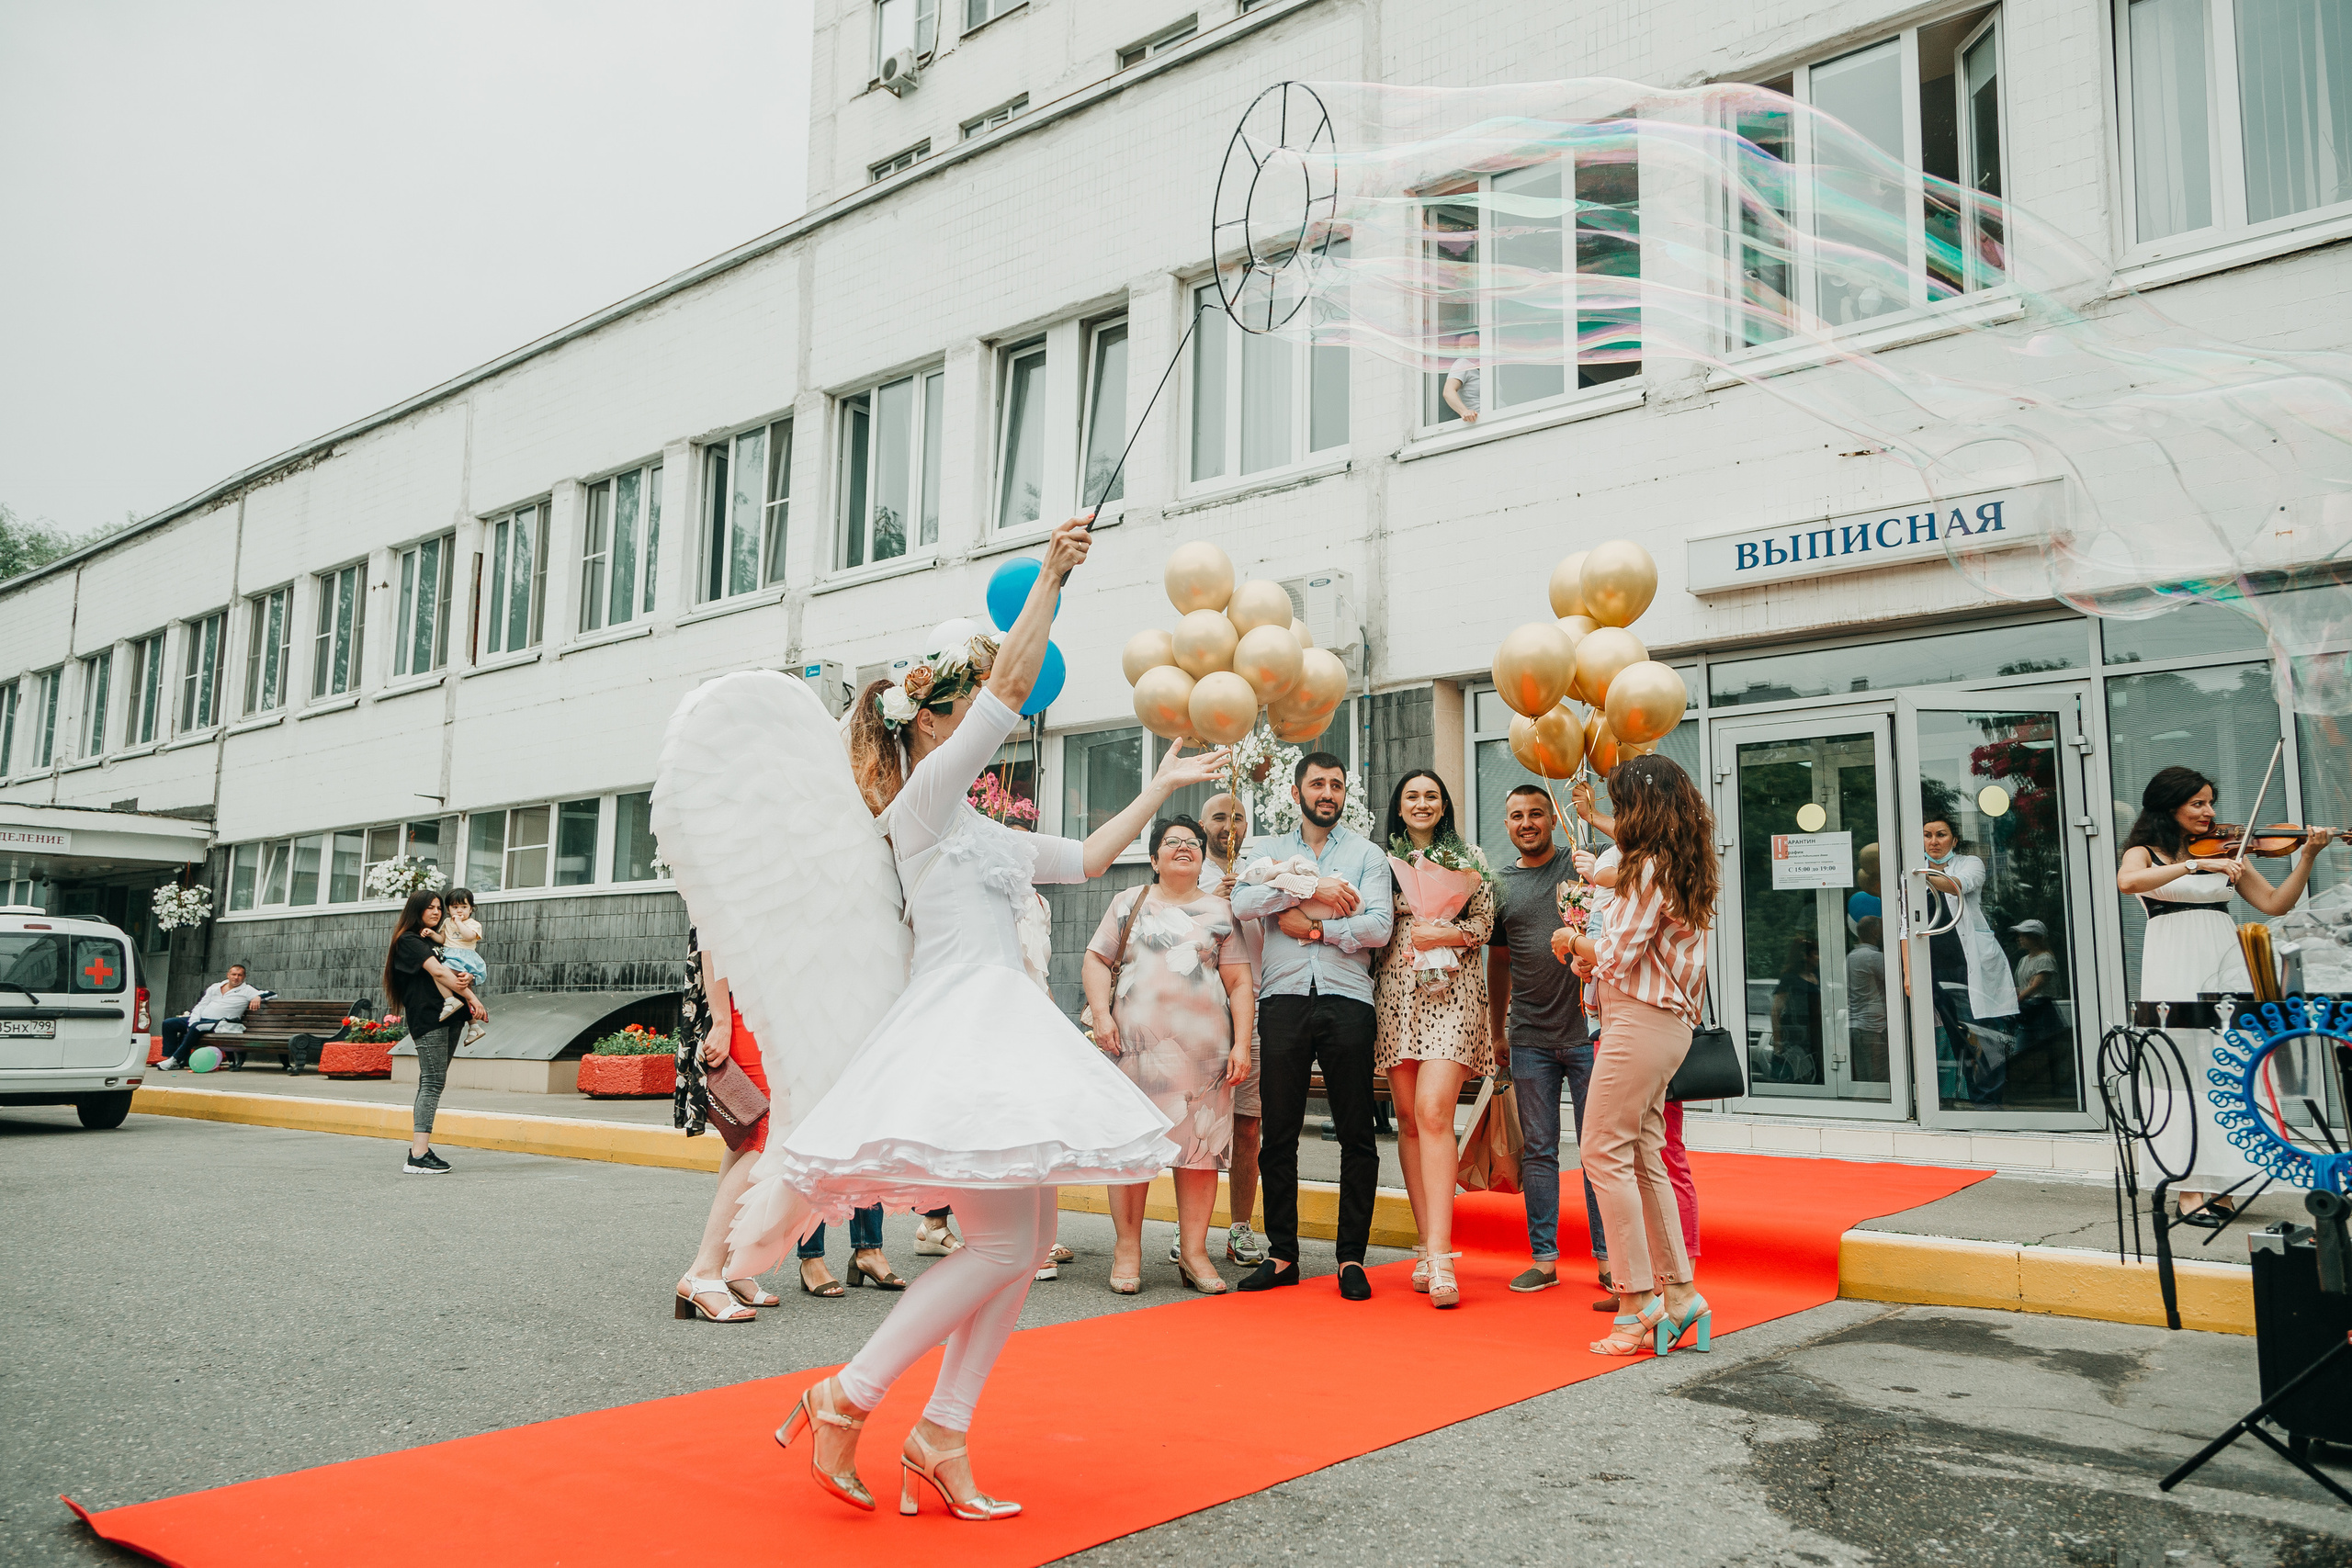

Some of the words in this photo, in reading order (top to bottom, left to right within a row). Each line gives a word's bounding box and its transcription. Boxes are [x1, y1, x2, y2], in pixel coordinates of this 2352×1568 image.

[1735, 501, 2006, 571] ВЫПИСНАЯ
[0, 1021, 28, 1032] 5НХ
[32, 1021, 51, 1030] 799
